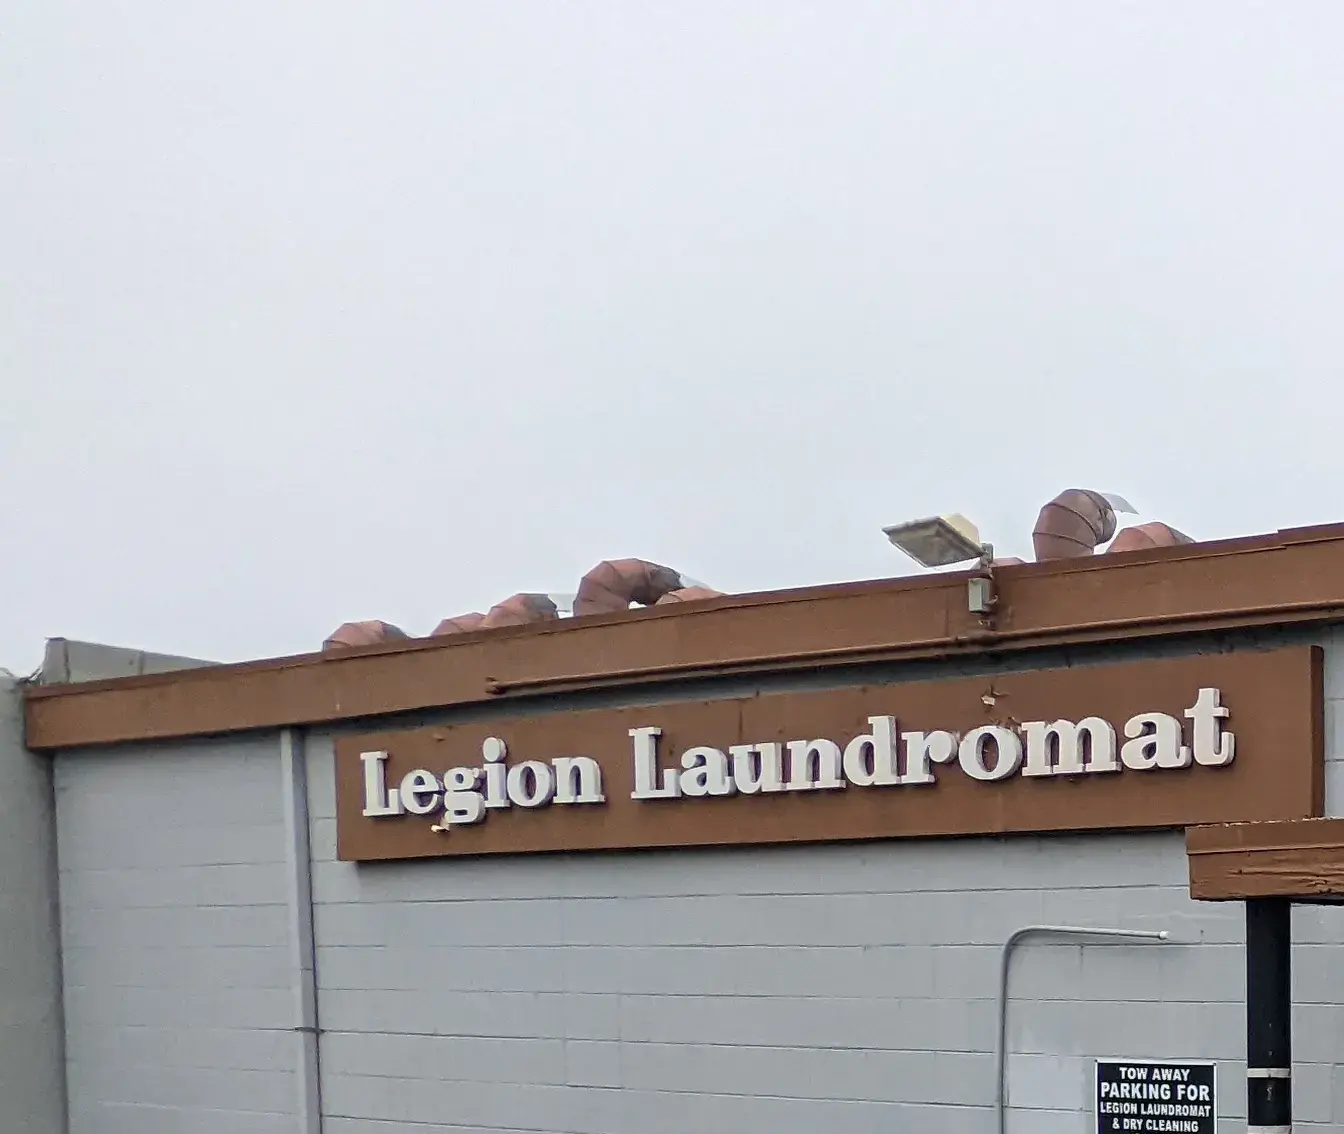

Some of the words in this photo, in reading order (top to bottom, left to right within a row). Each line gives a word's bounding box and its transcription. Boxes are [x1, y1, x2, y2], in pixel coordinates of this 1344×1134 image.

[360, 736, 606, 825] Legion
[628, 687, 1236, 801] Laundromat
[1119, 1067, 1148, 1080] TOW
[1152, 1068, 1190, 1082] AWAY
[1101, 1082, 1171, 1100] PARKING
[1177, 1084, 1210, 1101] FOR
[1100, 1101, 1138, 1114] LEGION
[1141, 1103, 1211, 1117] LAUNDROMAT
[1112, 1118, 1120, 1129] &
[1124, 1118, 1143, 1131] DRY
[1146, 1119, 1199, 1132] CLEANING
